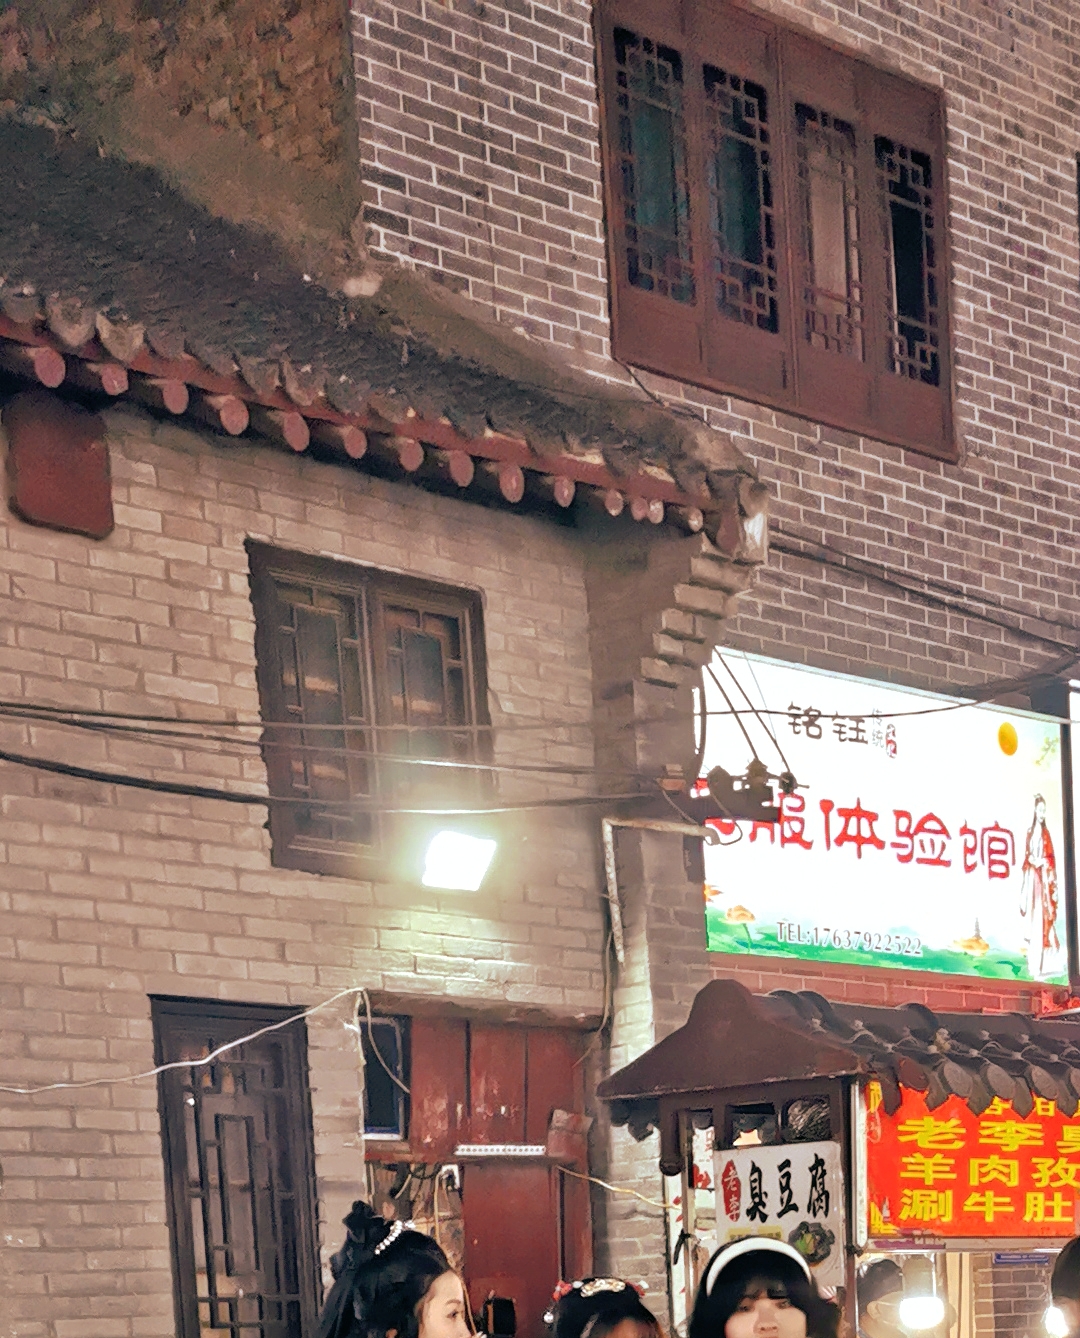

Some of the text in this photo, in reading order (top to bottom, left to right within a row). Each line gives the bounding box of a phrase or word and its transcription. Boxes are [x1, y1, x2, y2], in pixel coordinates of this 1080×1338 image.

[787, 701, 868, 744] 铭钰
[698, 780, 1016, 880] 服体验馆
[723, 1164, 742, 1222] 老李
[746, 1153, 830, 1223] 臭豆腐
